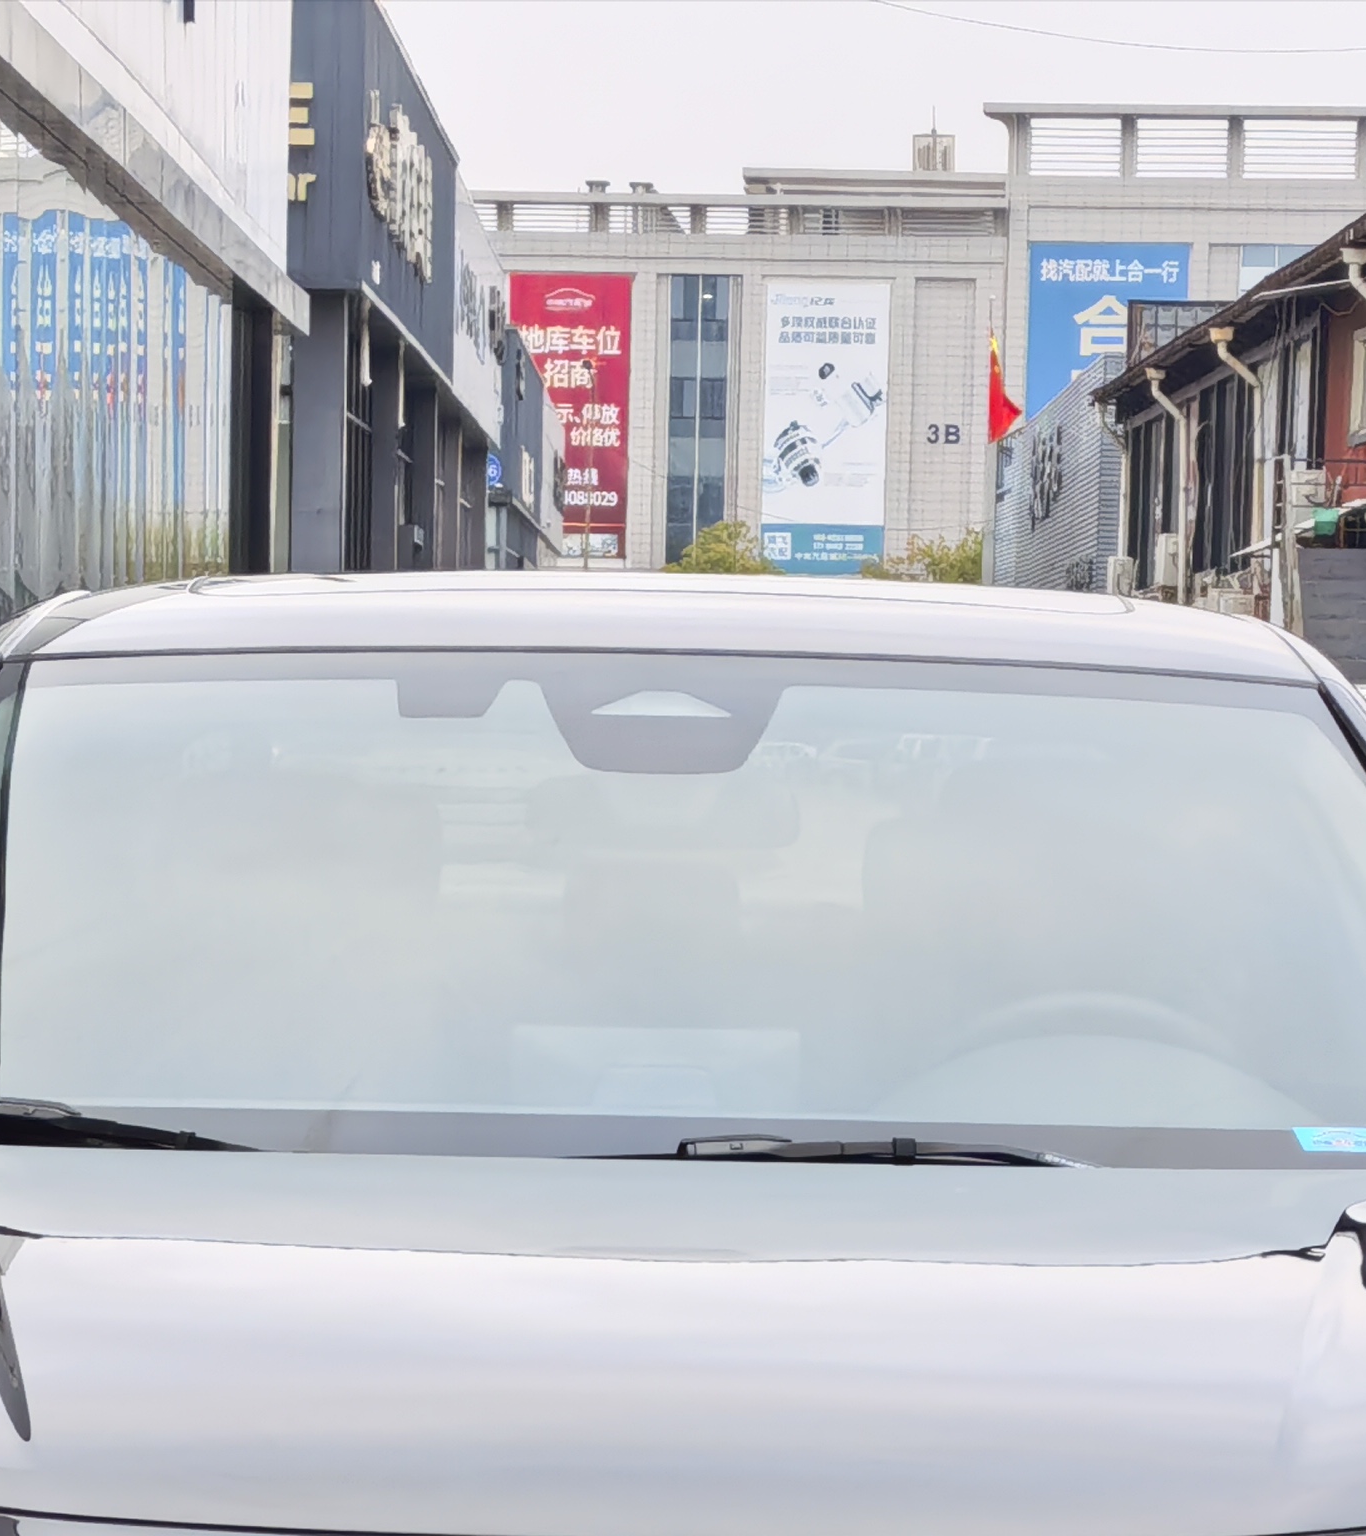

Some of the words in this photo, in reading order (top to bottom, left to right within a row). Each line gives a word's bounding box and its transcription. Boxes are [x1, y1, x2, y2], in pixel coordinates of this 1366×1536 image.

[1040, 258, 1180, 284] 找汽配就上合一行
[519, 324, 622, 355] 地库车位
[543, 358, 594, 389] 招商
[926, 424, 961, 445] 3B
